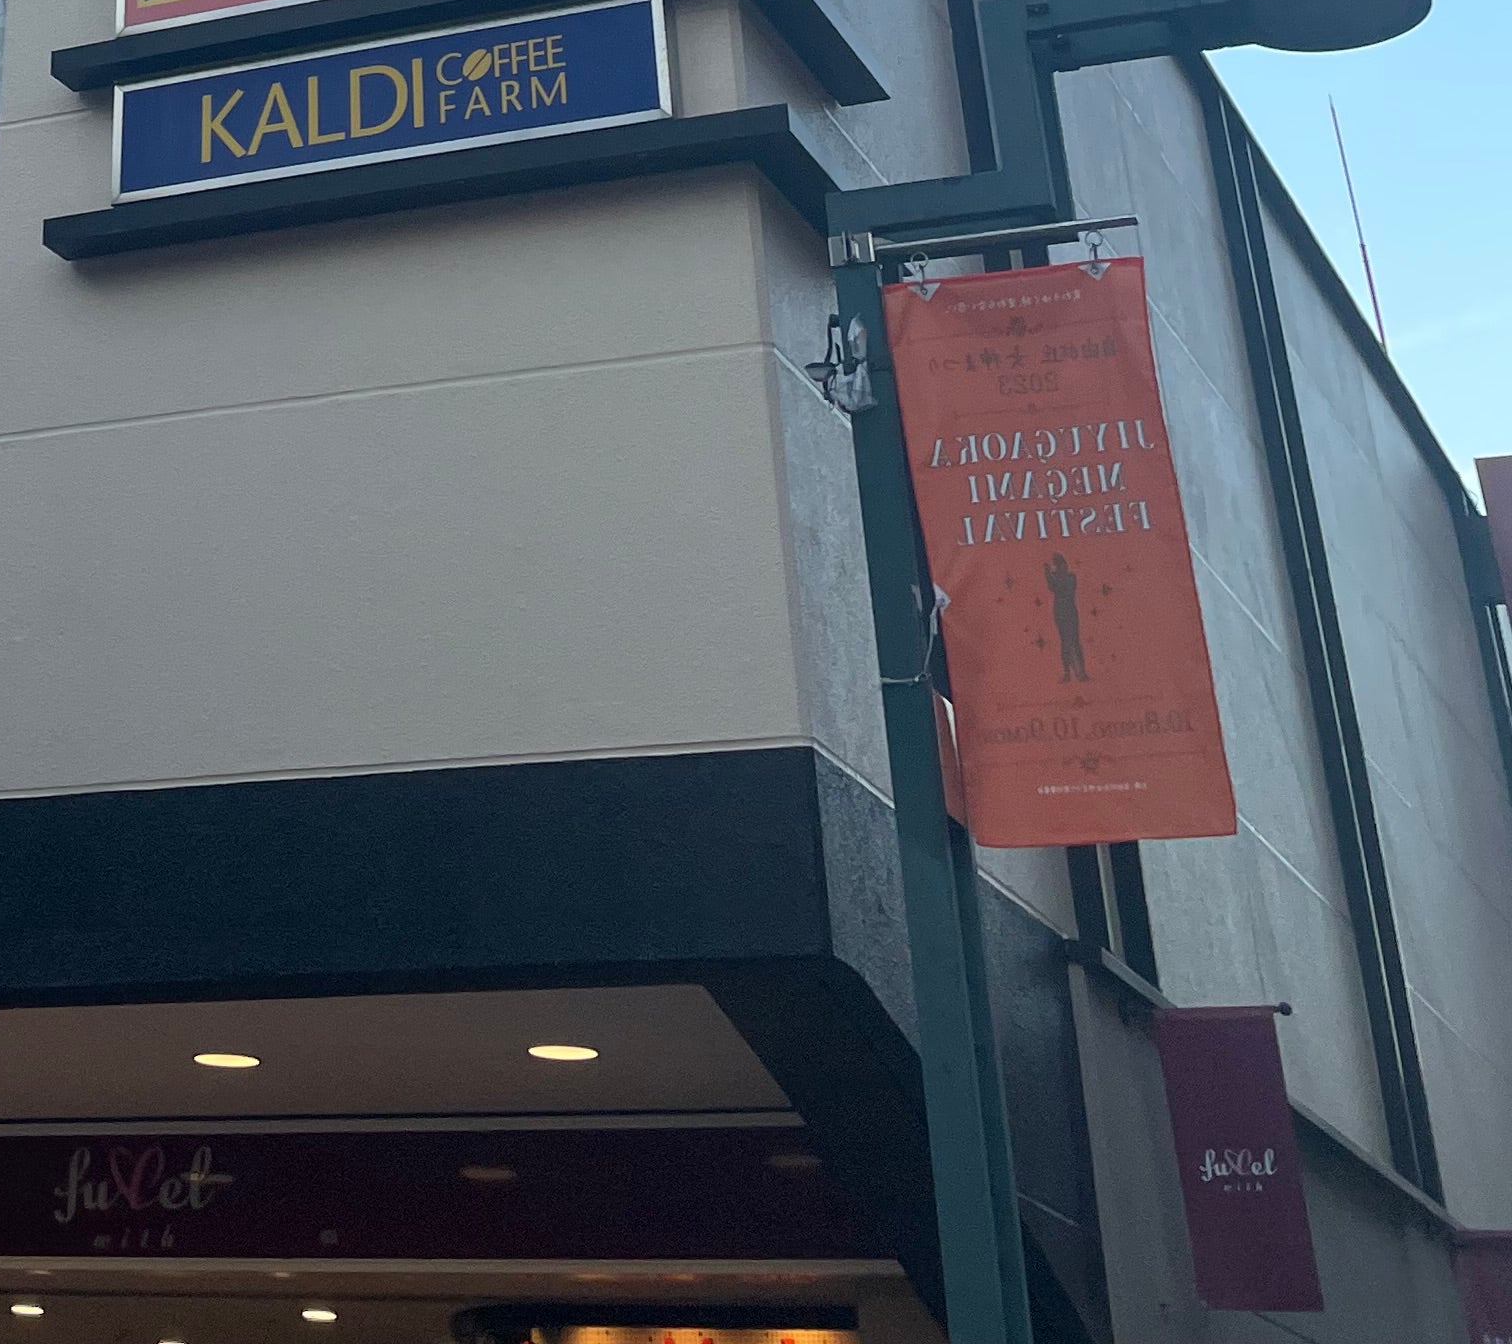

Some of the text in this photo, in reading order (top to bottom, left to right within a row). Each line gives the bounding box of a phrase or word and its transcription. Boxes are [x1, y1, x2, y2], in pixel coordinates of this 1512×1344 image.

[435, 34, 566, 87] COFFEE
[199, 56, 425, 163] KALDI
[438, 72, 569, 124] FARM
